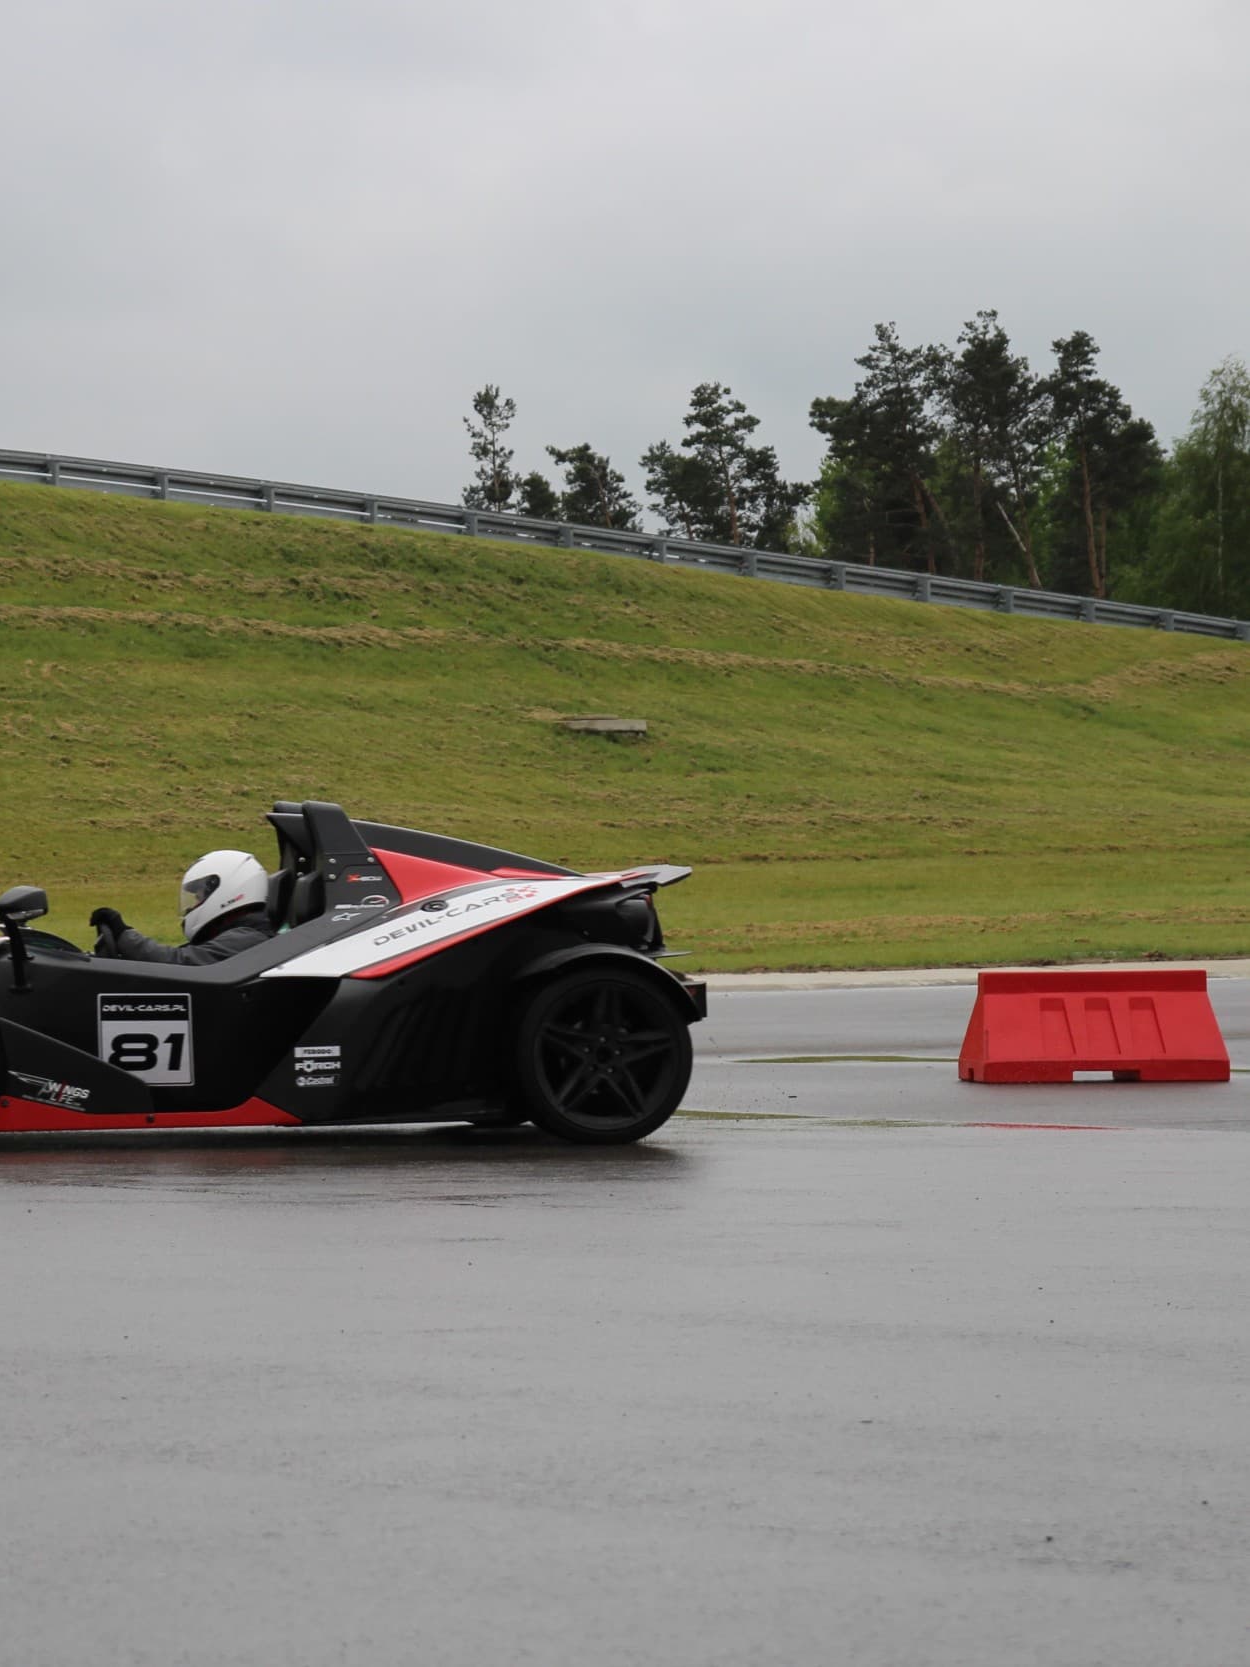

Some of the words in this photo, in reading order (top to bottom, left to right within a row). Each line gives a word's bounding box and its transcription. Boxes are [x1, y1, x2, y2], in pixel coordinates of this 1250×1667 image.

[102, 1004, 187, 1012] DEVIL-CARS.PL
[108, 1033, 186, 1071] 81
[295, 1060, 341, 1072] FÖRCH
